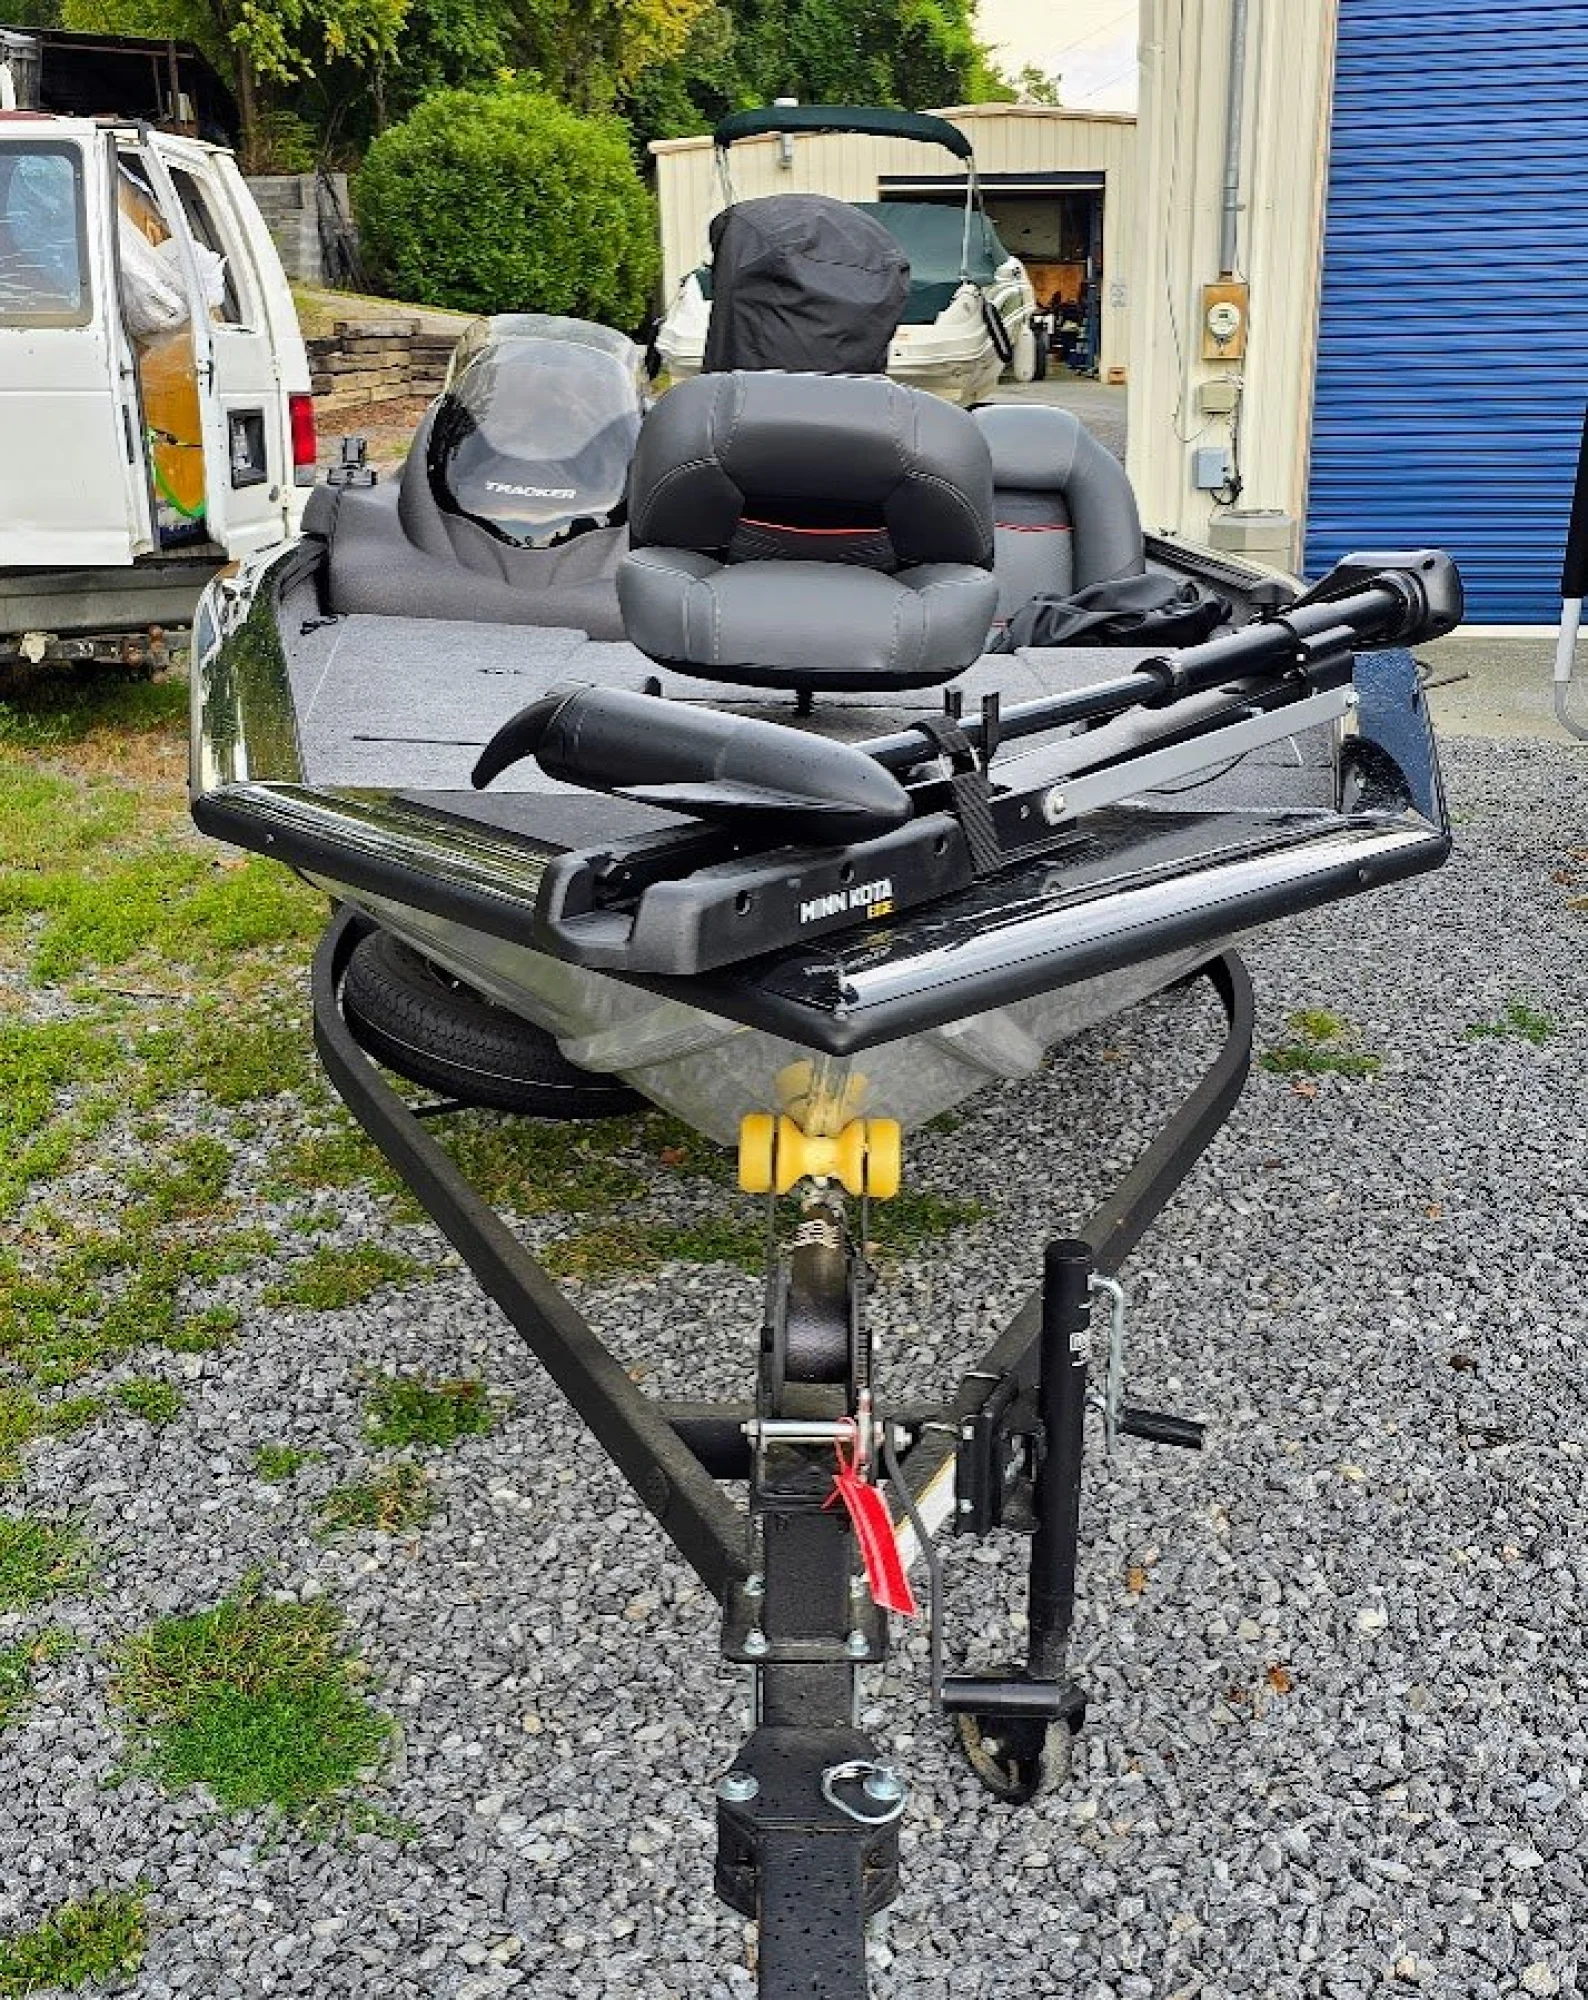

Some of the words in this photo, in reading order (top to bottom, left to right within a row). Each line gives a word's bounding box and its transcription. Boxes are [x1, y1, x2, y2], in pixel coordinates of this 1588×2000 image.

[485, 481, 576, 499] TRACKER
[800, 891, 848, 924] MINN
[849, 878, 893, 908] KOTA
